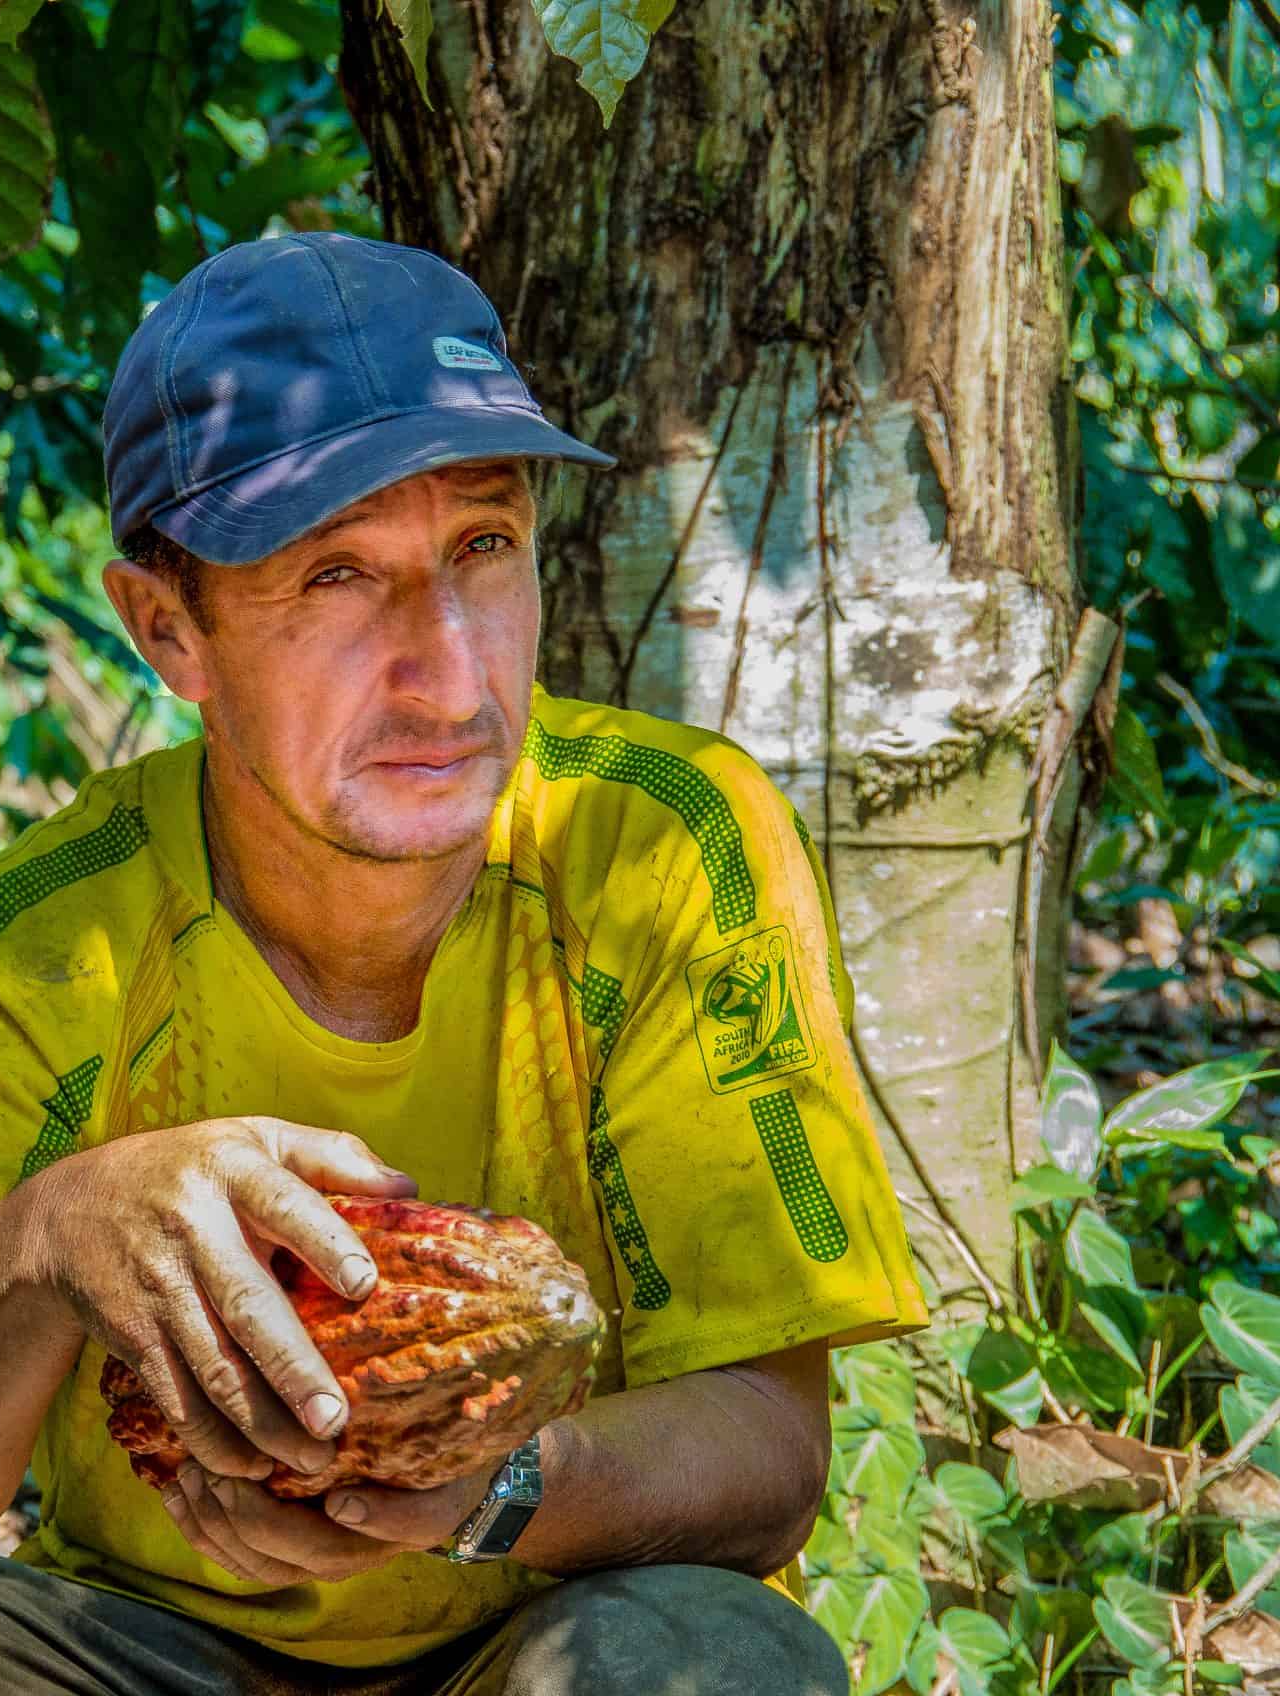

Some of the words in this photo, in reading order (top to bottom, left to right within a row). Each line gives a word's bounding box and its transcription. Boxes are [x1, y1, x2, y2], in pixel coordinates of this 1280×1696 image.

[715, 1026, 751, 1044] SOUTH
[713, 1040, 750, 1057] AFRICA
[731, 1050, 750, 1064] 2010
[768, 1038, 807, 1059] FIFA
